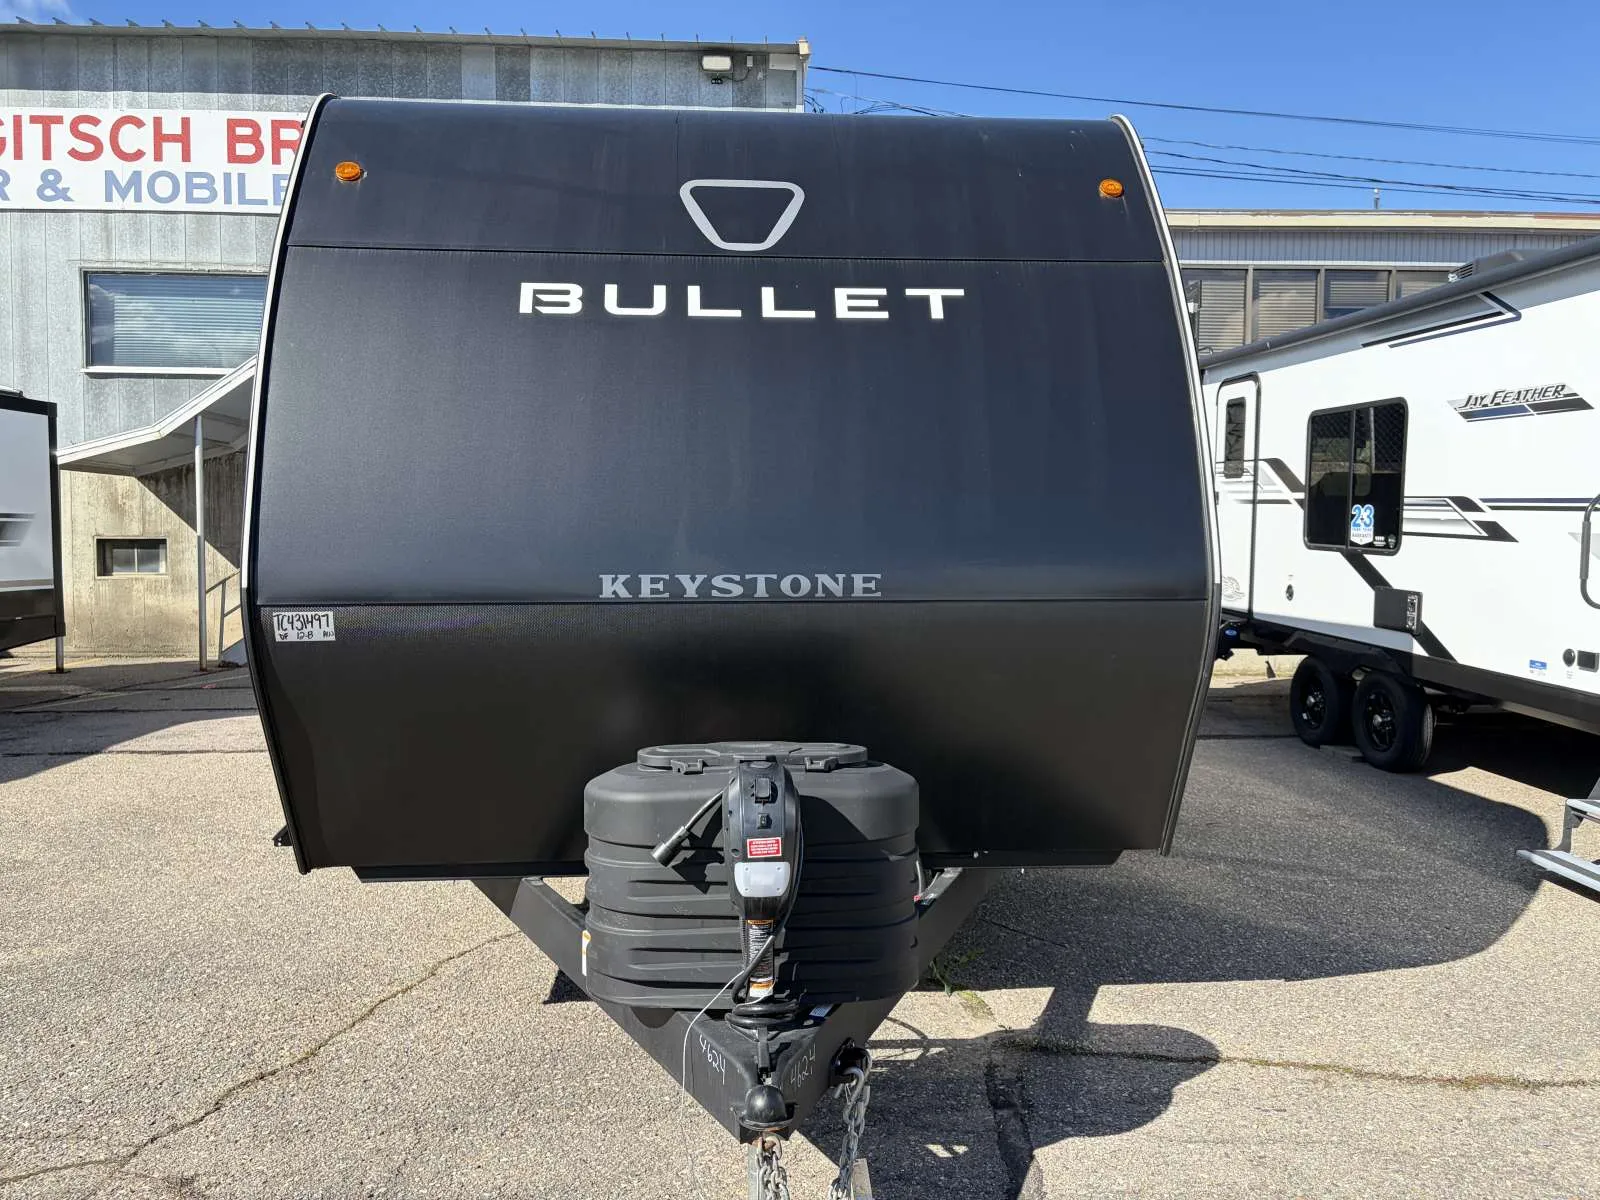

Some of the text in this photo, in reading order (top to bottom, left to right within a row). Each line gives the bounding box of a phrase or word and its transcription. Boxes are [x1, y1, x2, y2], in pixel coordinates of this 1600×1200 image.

[0, 113, 191, 163] ITSCH
[36, 168, 75, 202] &
[518, 281, 966, 321] BULLET
[1458, 383, 1567, 409] JAY FEATHER
[1351, 504, 1373, 528] 23
[598, 573, 882, 599] KEYSTONE
